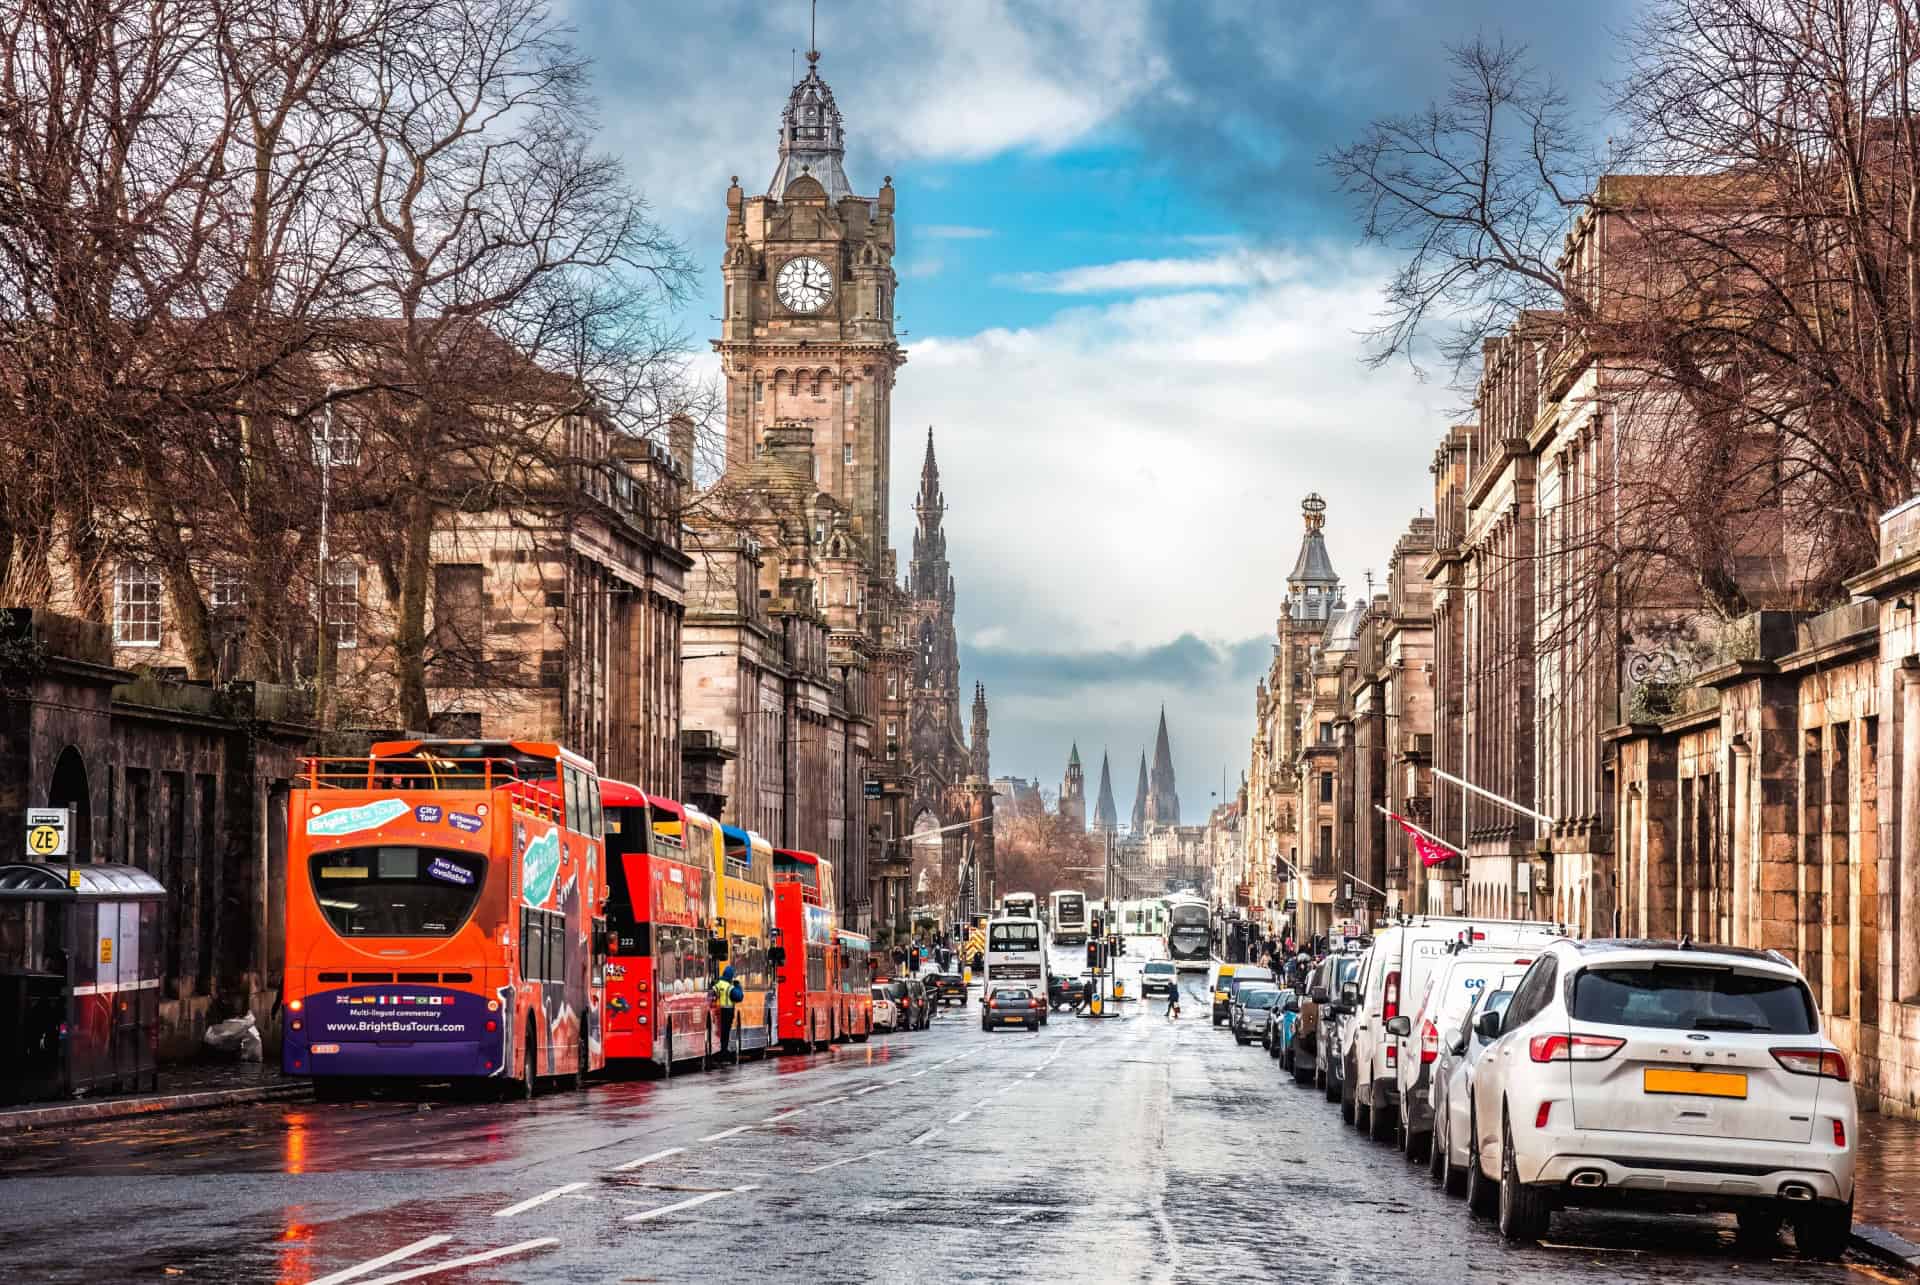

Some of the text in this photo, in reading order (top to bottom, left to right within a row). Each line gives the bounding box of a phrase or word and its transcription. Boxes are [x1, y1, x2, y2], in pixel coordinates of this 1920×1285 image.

[419, 806, 438, 815] City
[419, 814, 438, 822] Tour
[36, 831, 53, 849] ZE
[434, 857, 472, 877] Two tours
[433, 868, 467, 884] available
[350, 1008, 441, 1018] Multi-lingual commentary
[326, 1021, 465, 1033] www.BrightBusTours.com
